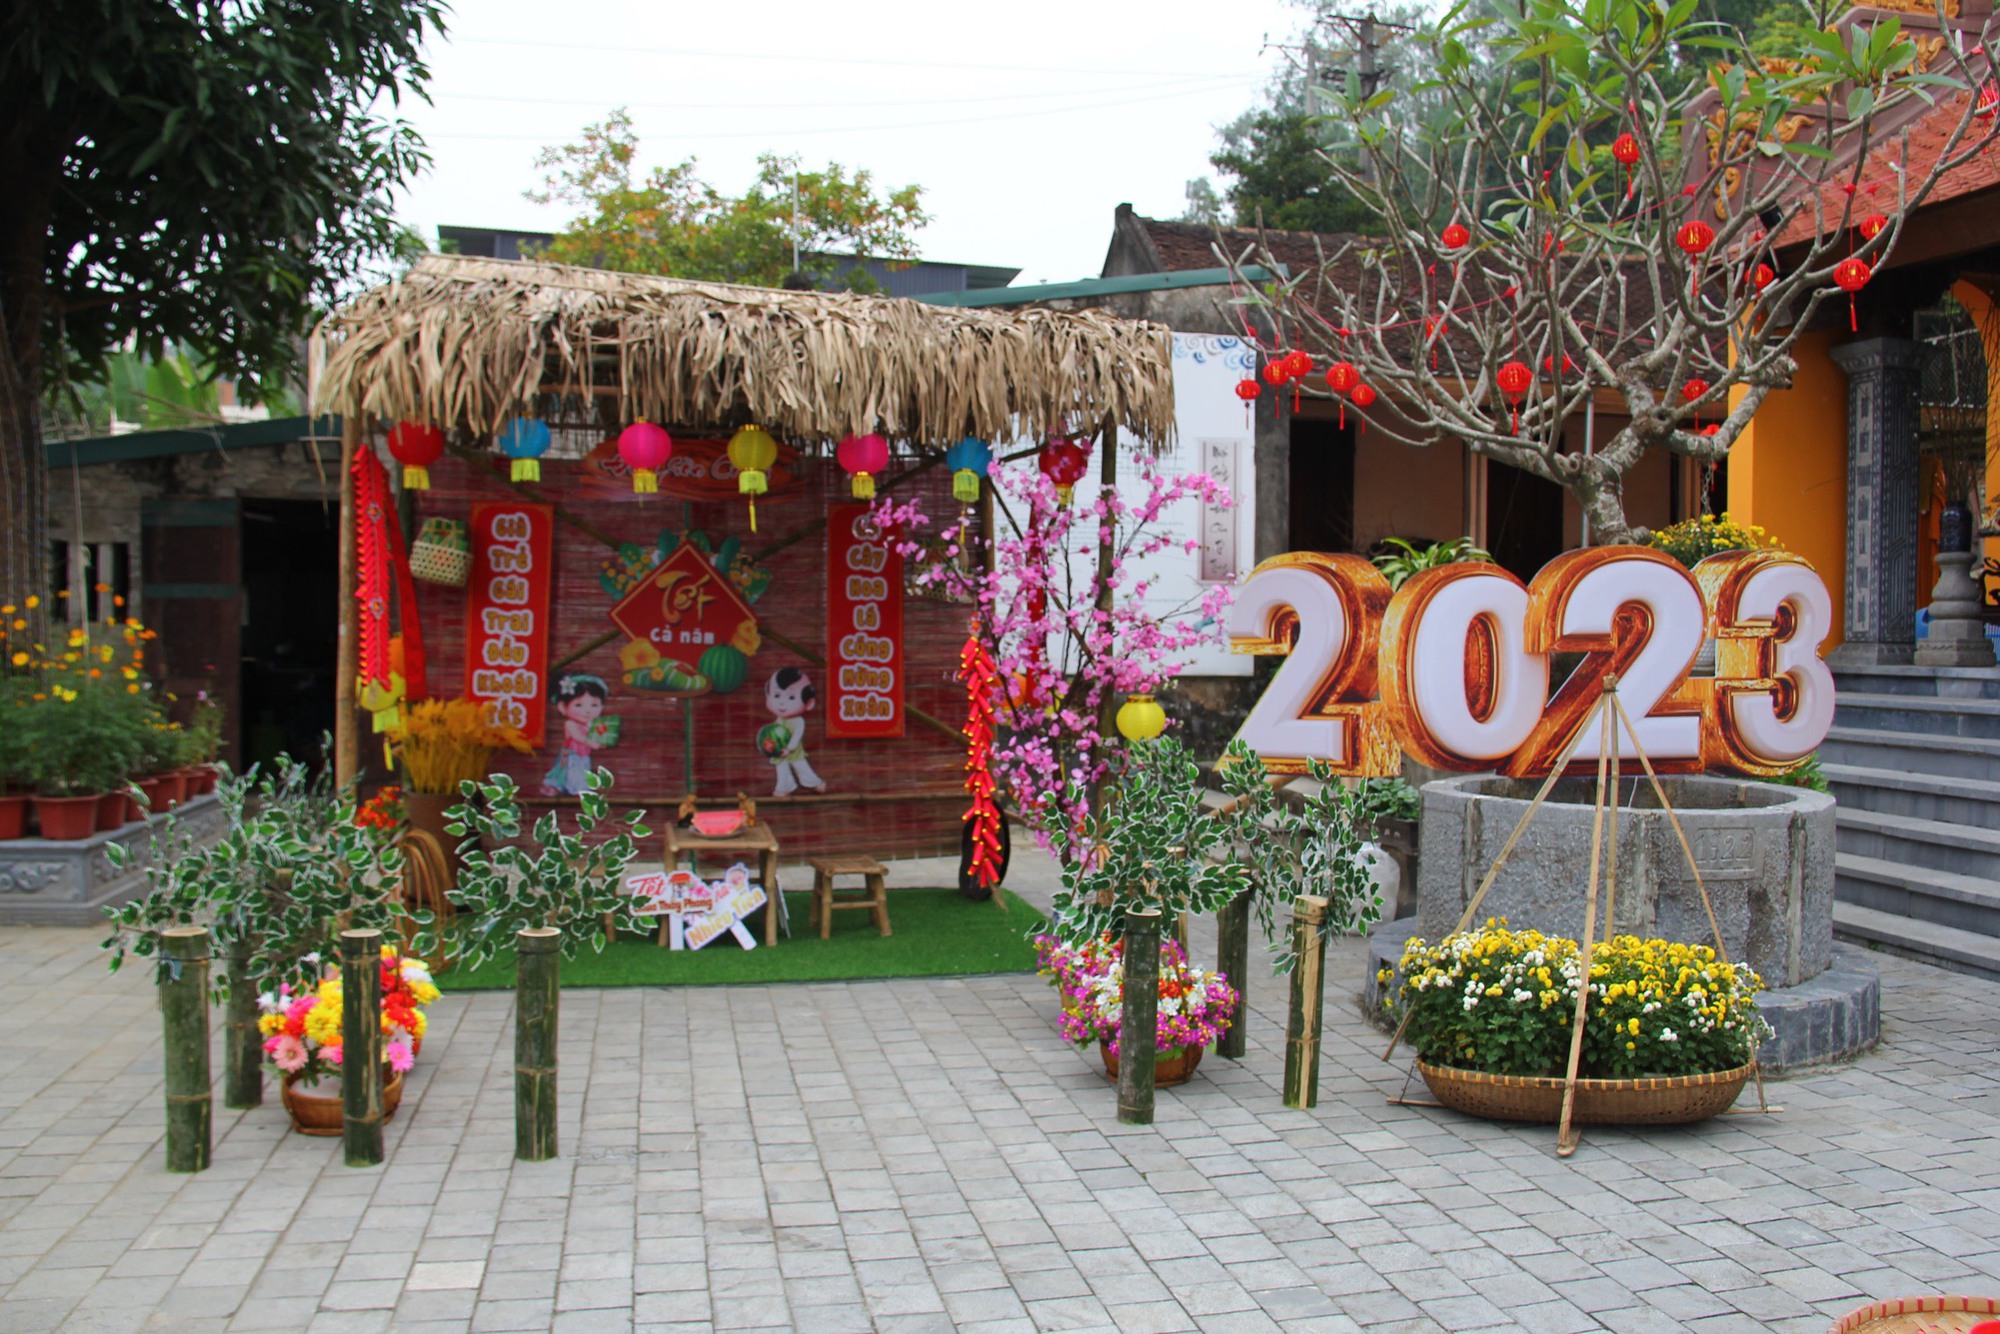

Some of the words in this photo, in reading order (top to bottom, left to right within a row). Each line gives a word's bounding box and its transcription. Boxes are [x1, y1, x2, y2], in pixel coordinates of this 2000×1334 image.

[493, 513, 529, 540] Già
[489, 544, 531, 571] Trẻ
[848, 544, 886, 571] Cây
[654, 571, 716, 624] Tết
[847, 576, 887, 599] Hoa
[483, 609, 532, 634] Trai
[854, 603, 879, 629] Lá
[484, 635, 528, 665] Đều
[1222, 550, 1836, 774] 2023
[474, 670, 536, 697] Khoái
[840, 664, 892, 691] Mừng
[841, 694, 892, 719] Xuân
[630, 875, 666, 897] Tết
